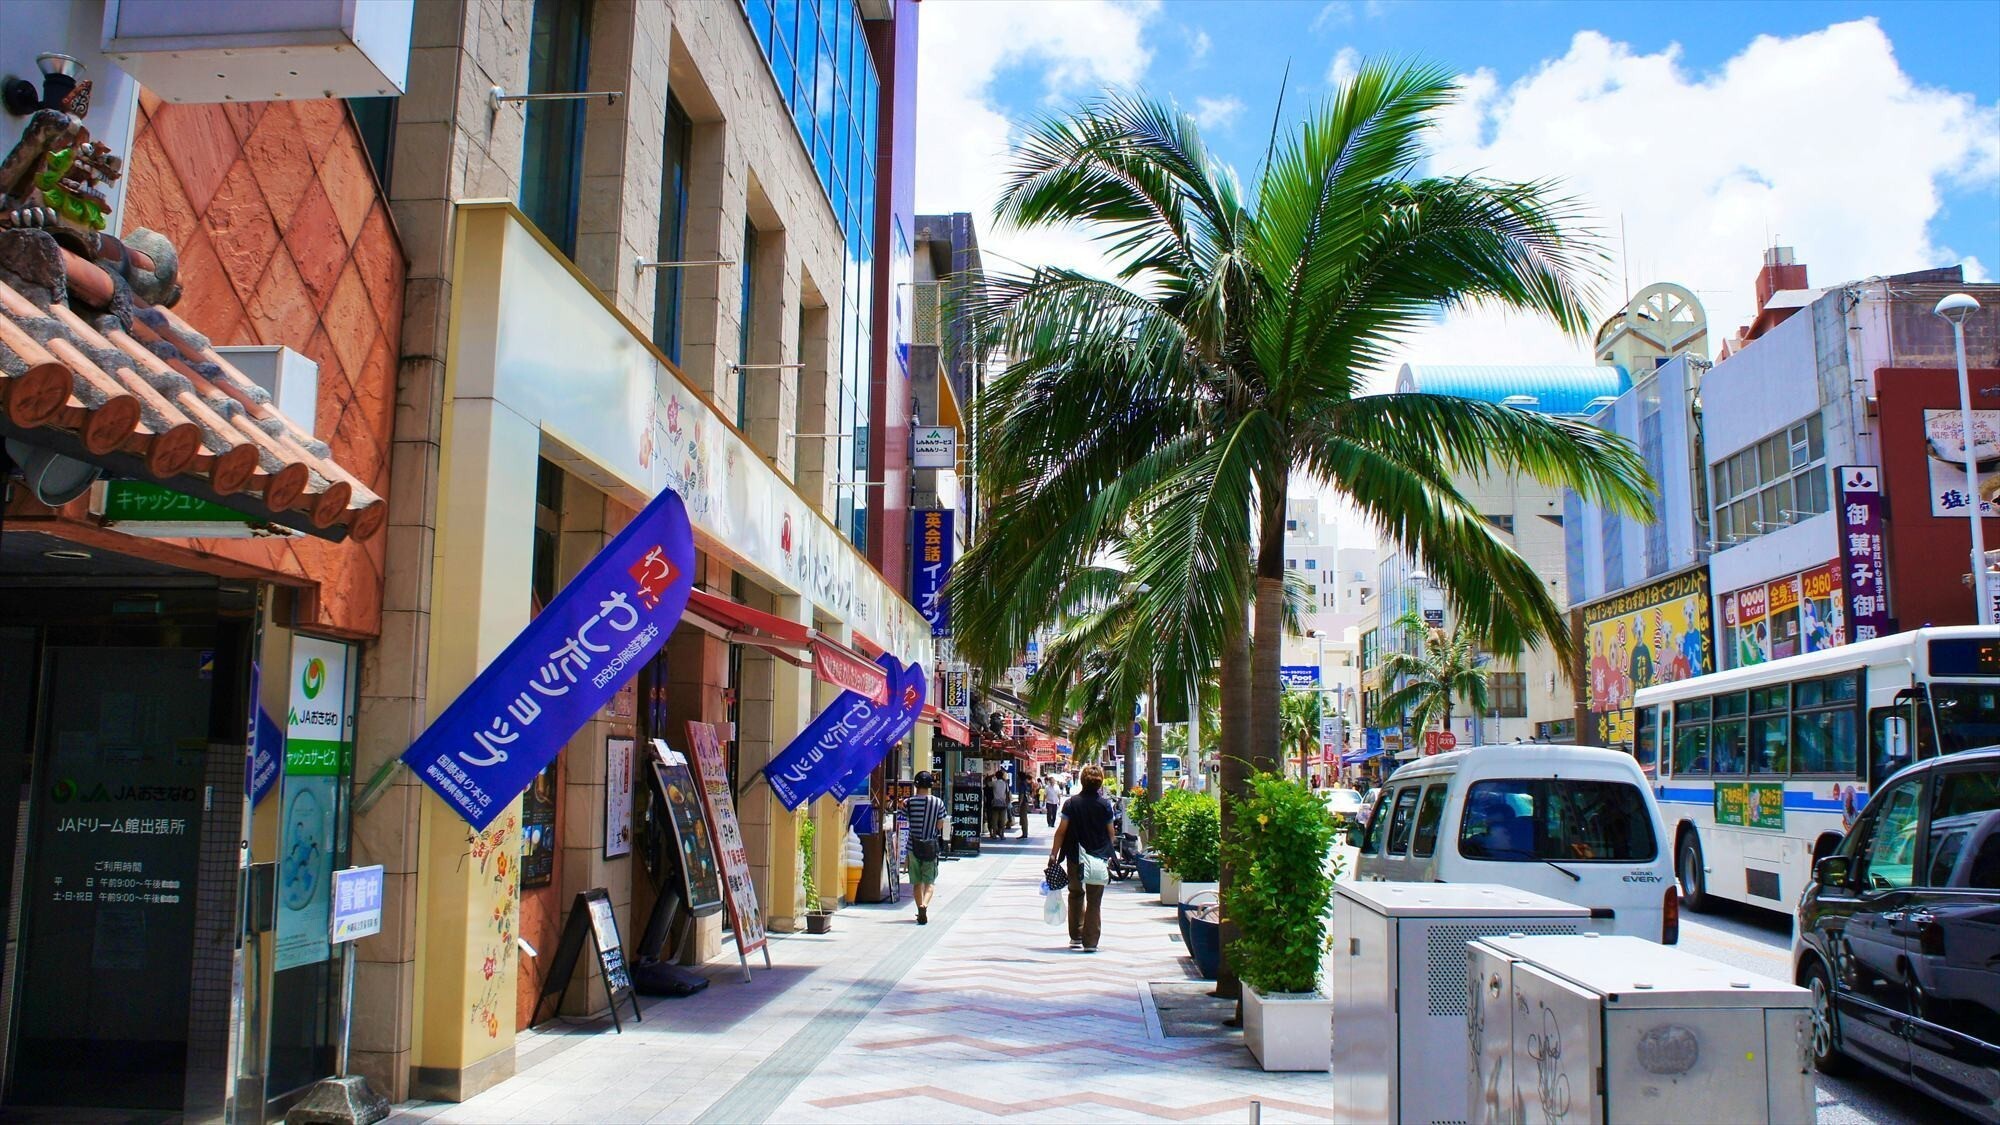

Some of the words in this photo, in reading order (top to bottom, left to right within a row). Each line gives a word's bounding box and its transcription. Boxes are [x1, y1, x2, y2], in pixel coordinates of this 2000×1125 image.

[924, 512, 942, 562] 英会話
[638, 545, 670, 610] わした
[1846, 503, 1877, 643] 御菓子御殿
[459, 590, 639, 767] わしたショップ
[592, 622, 659, 690] 沖縄物産のお店
[299, 710, 338, 726] JAおきなわ
[783, 699, 872, 782] わしたショップ
[114, 785, 197, 802] JAおきなわ
[436, 753, 493, 808] 国際通り本店
[954, 793, 979, 802] SILVER
[57, 817, 186, 835] JAドリーム館出張所
[94, 861, 142, 873] ご利用時間
[1622, 875, 1662, 884] EVERY
